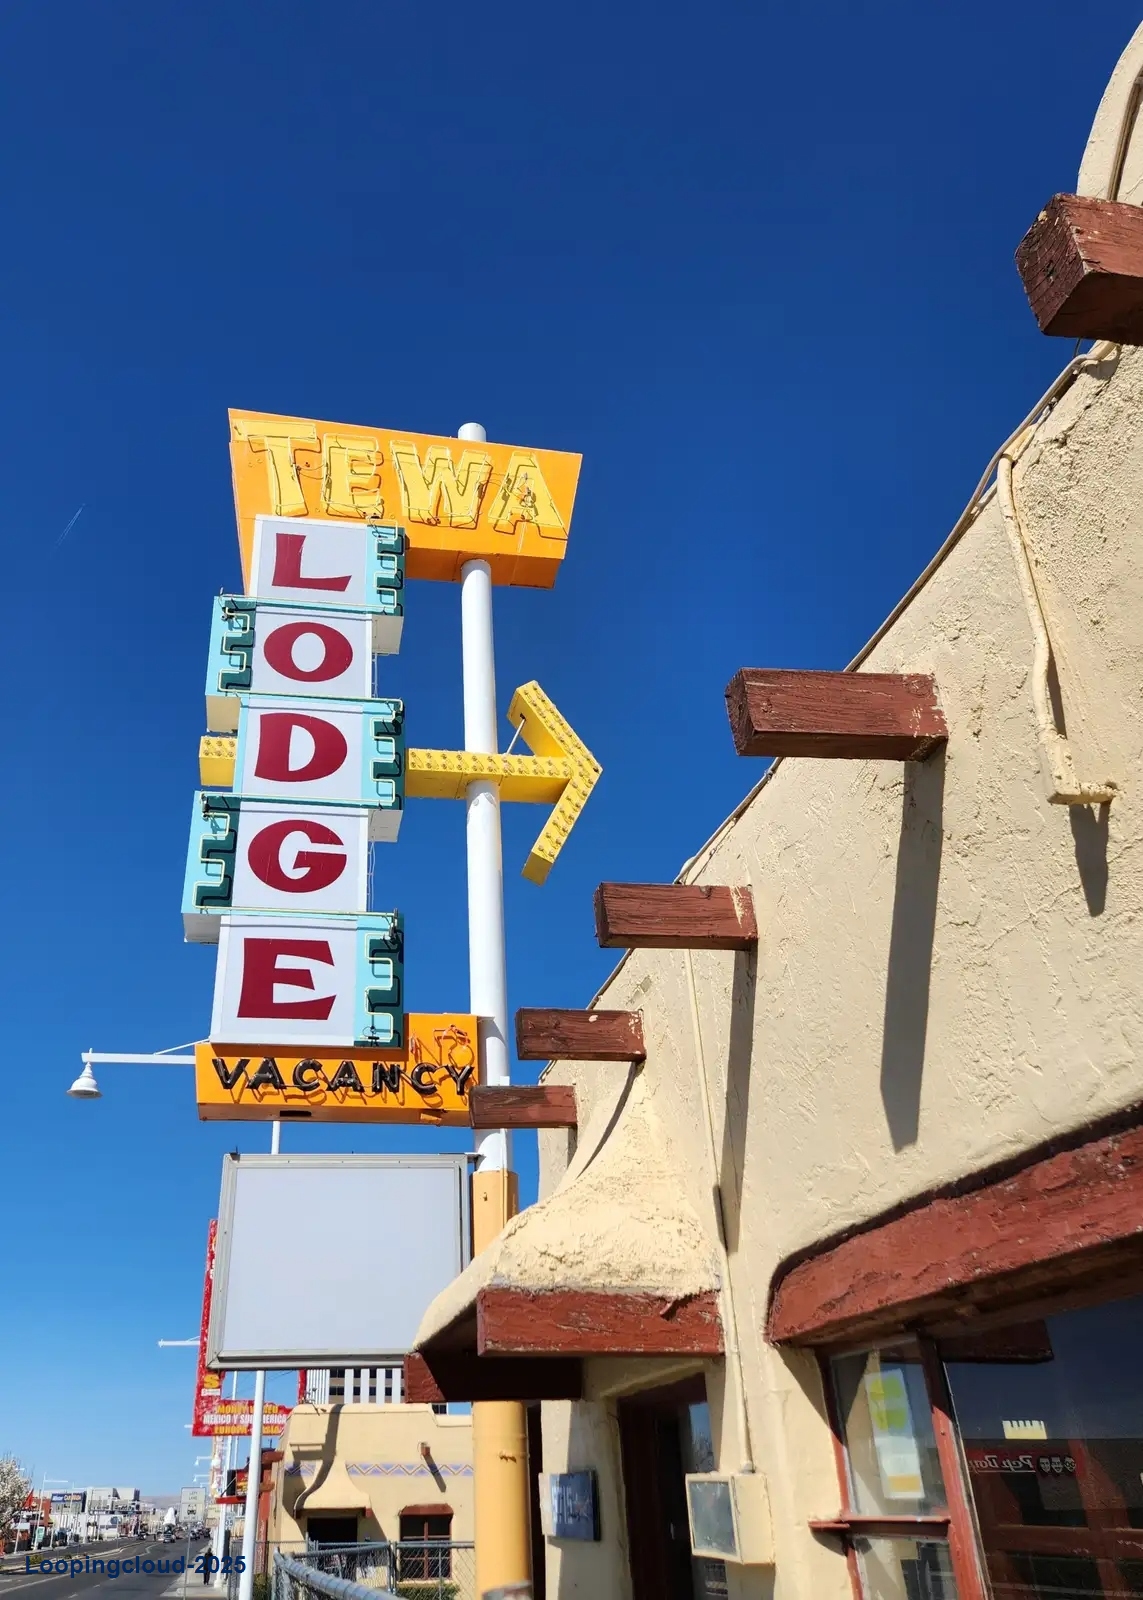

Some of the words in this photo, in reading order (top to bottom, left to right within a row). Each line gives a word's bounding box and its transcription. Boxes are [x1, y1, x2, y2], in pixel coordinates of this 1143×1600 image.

[233, 418, 569, 540] TEWA
[236, 532, 354, 1021] LODGE
[211, 1056, 475, 1096] VACANCY
[203, 1413, 231, 1425] MEXICO
[240, 1414, 287, 1425] SUDERICA
[217, 1404, 247, 1414] MONEY
[214, 1425, 248, 1435] EUROPA
